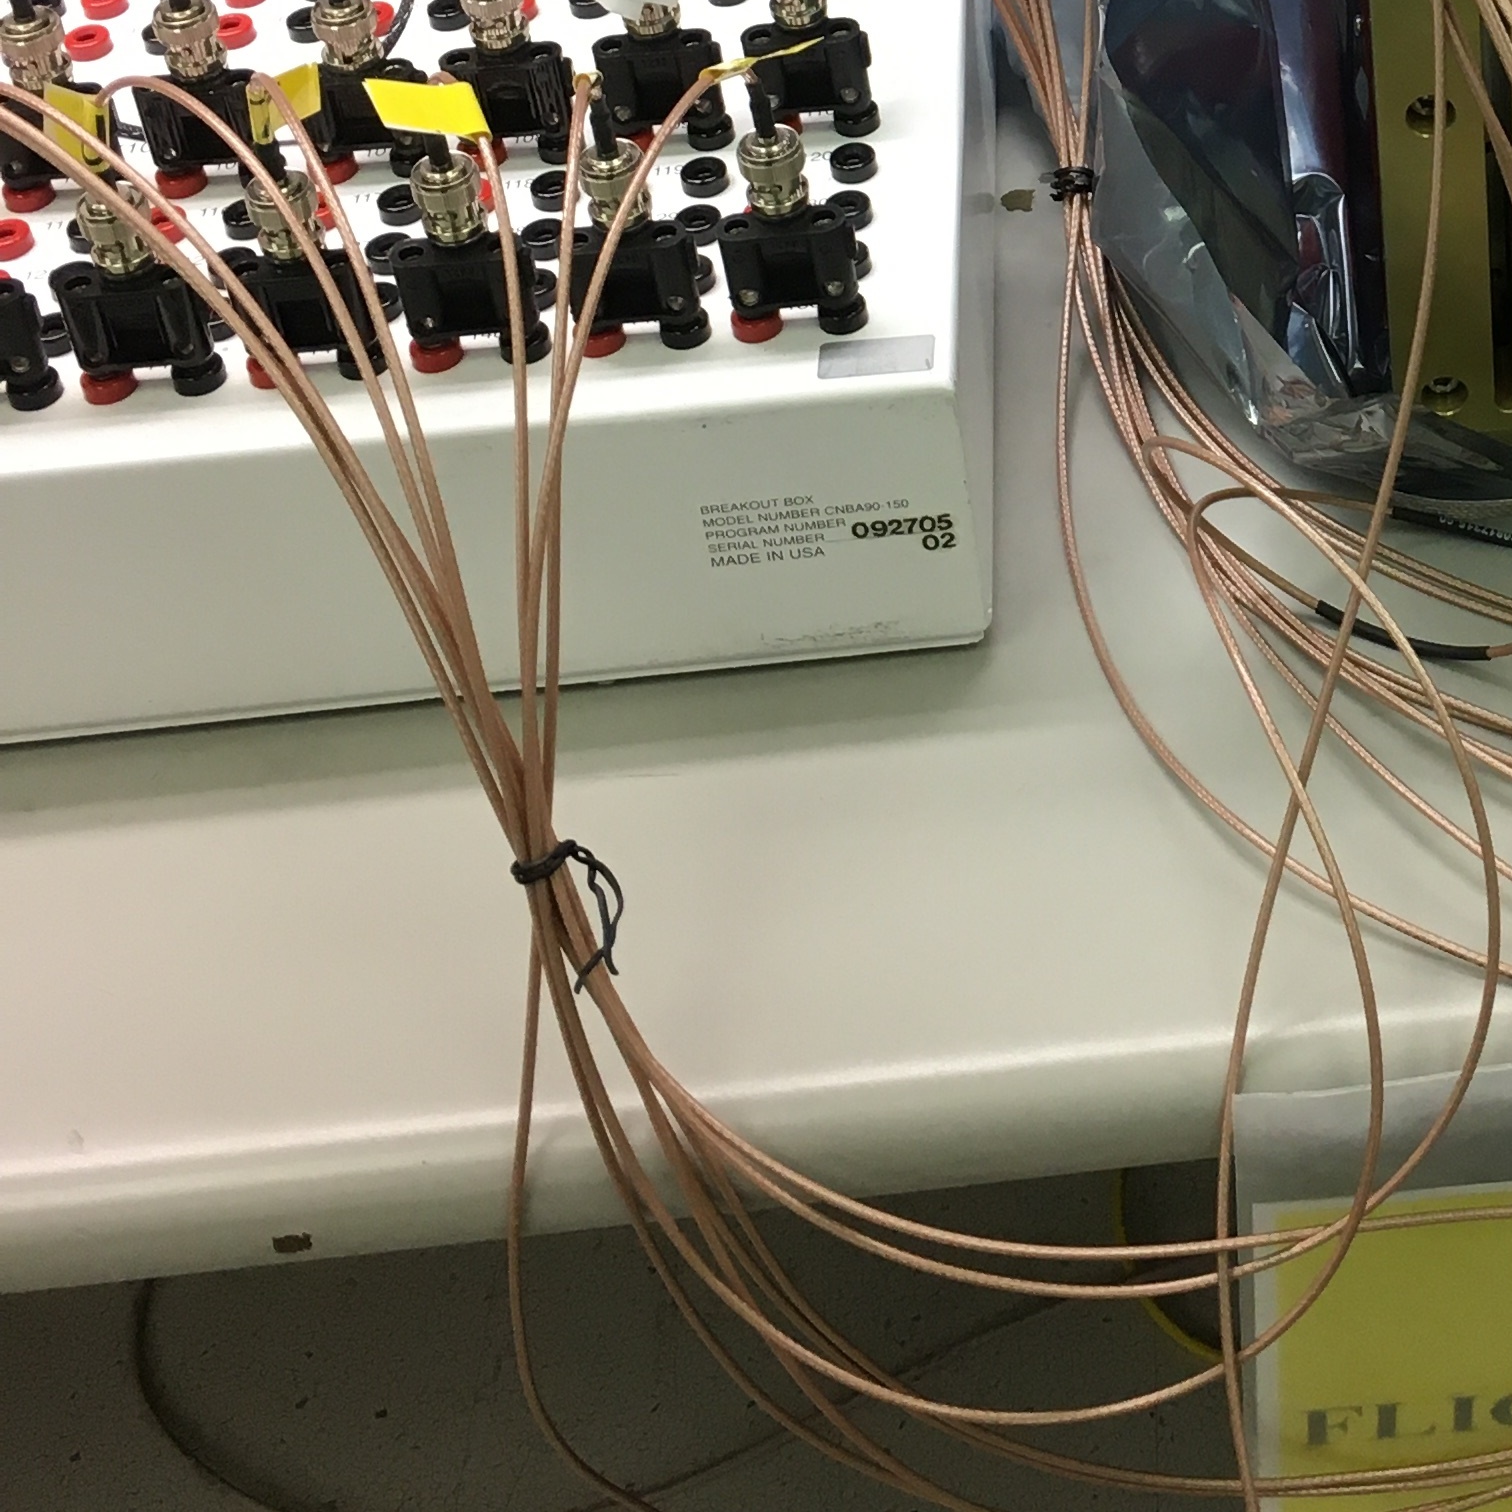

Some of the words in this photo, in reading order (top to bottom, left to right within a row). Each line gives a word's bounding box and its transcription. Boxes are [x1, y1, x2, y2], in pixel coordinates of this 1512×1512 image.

[700, 498, 779, 516] BREAKOUT
[783, 495, 814, 507] BOX
[702, 514, 755, 528] MODEL
[757, 507, 821, 523] NUMBER
[705, 526, 780, 540] PROGRAM
[784, 518, 847, 533] NUMBER
[851, 513, 954, 540] 092705
[708, 539, 759, 554] SERIAL
[763, 533, 826, 548] NUMBER
[922, 532, 957, 551] 02
[710, 552, 761, 568] MADE
[766, 550, 784, 562] IN
[789, 546, 826, 560] USA
